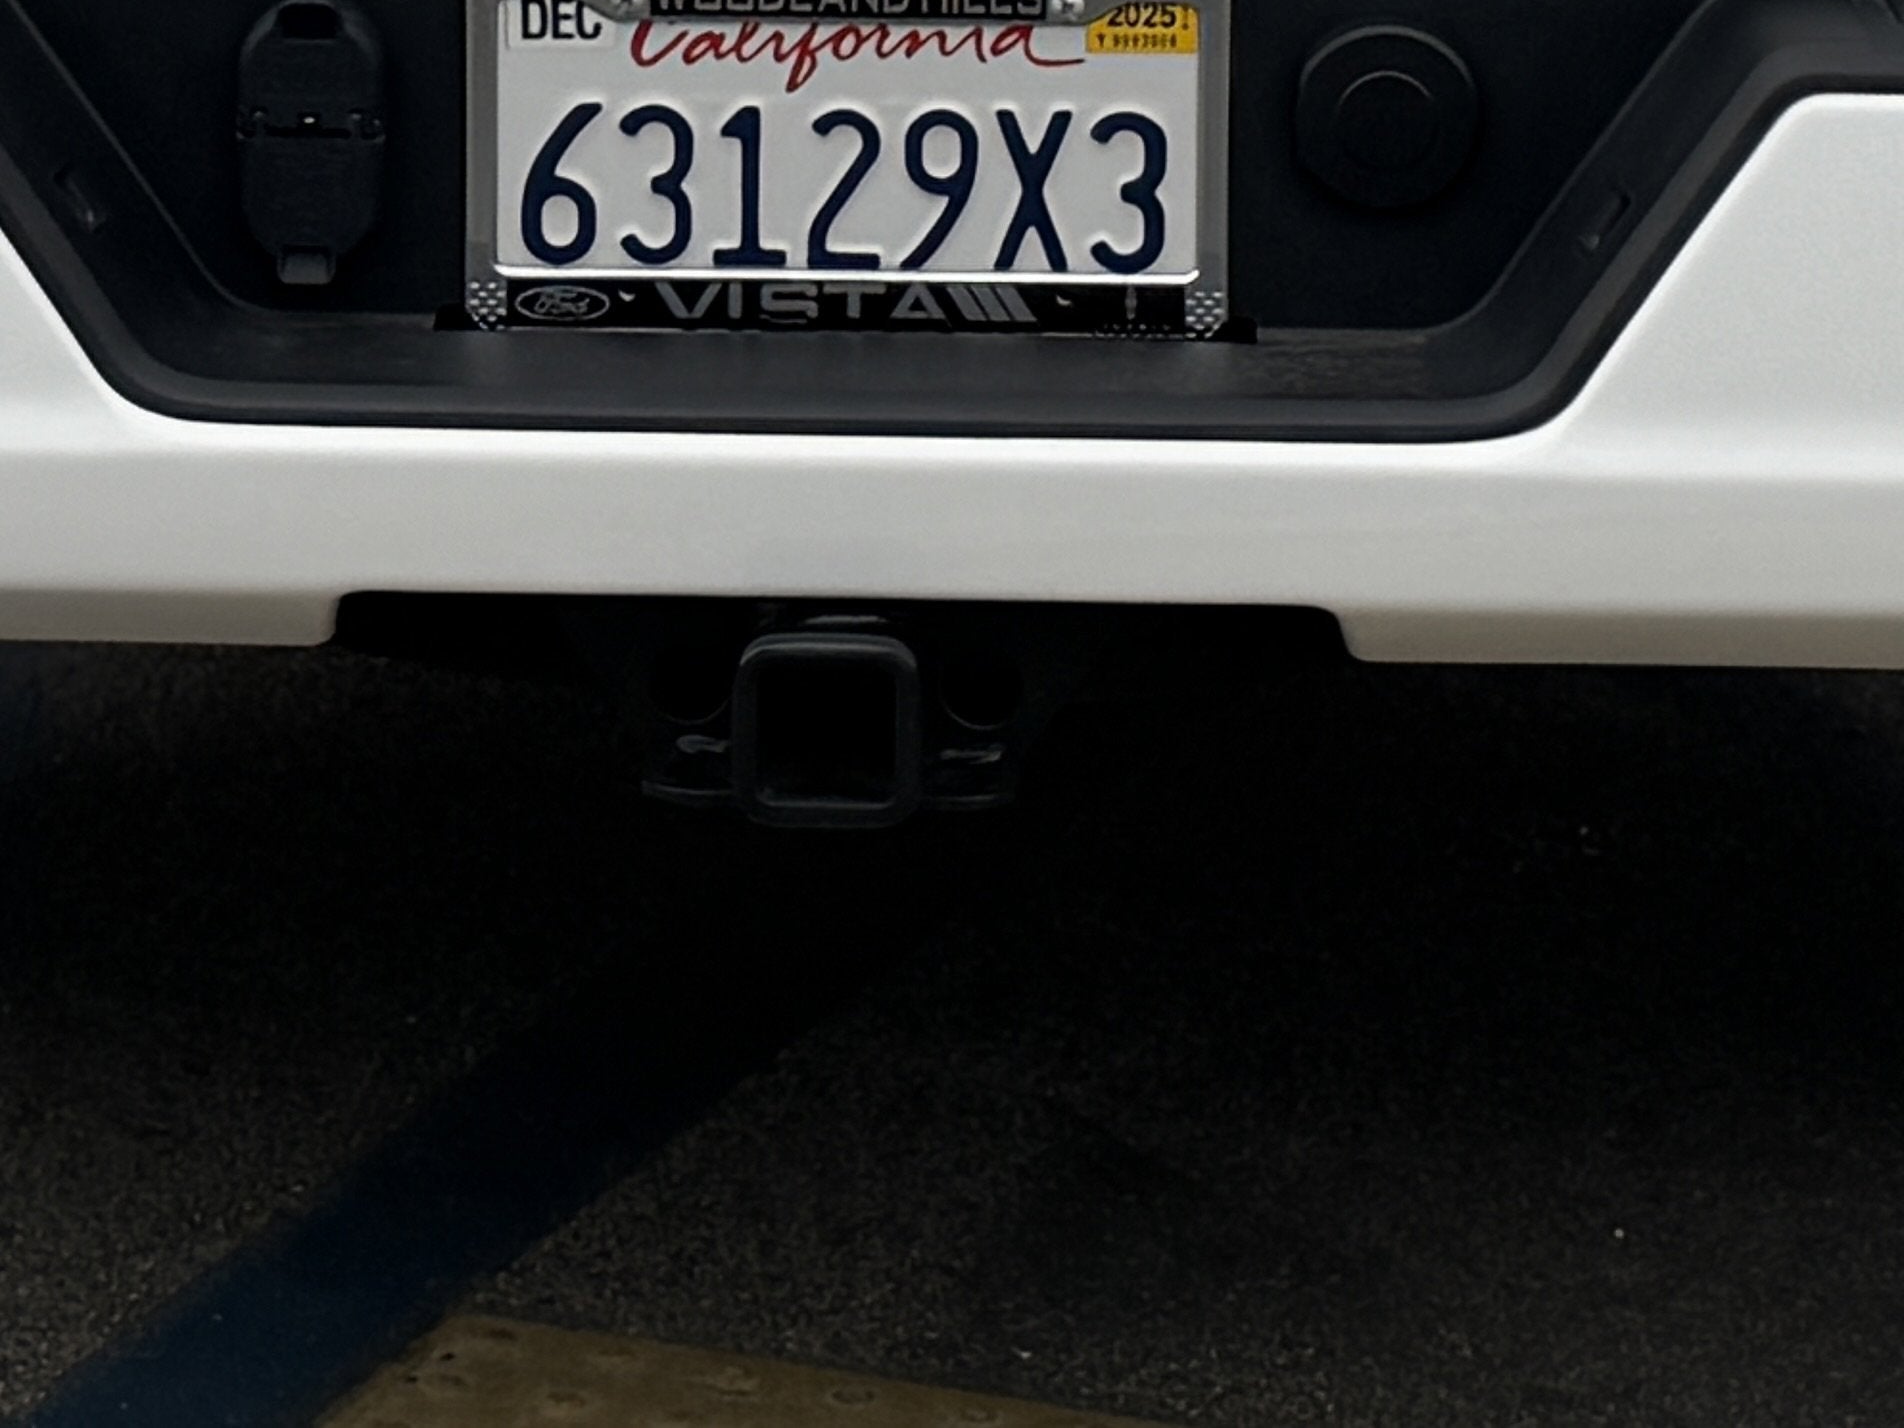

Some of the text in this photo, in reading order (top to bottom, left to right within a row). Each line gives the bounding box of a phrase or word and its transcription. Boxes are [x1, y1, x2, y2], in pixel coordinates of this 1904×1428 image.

[1107, 2, 1177, 29] 2025
[521, 102, 1168, 274] 63129X3
[654, 280, 947, 320] VISTA
